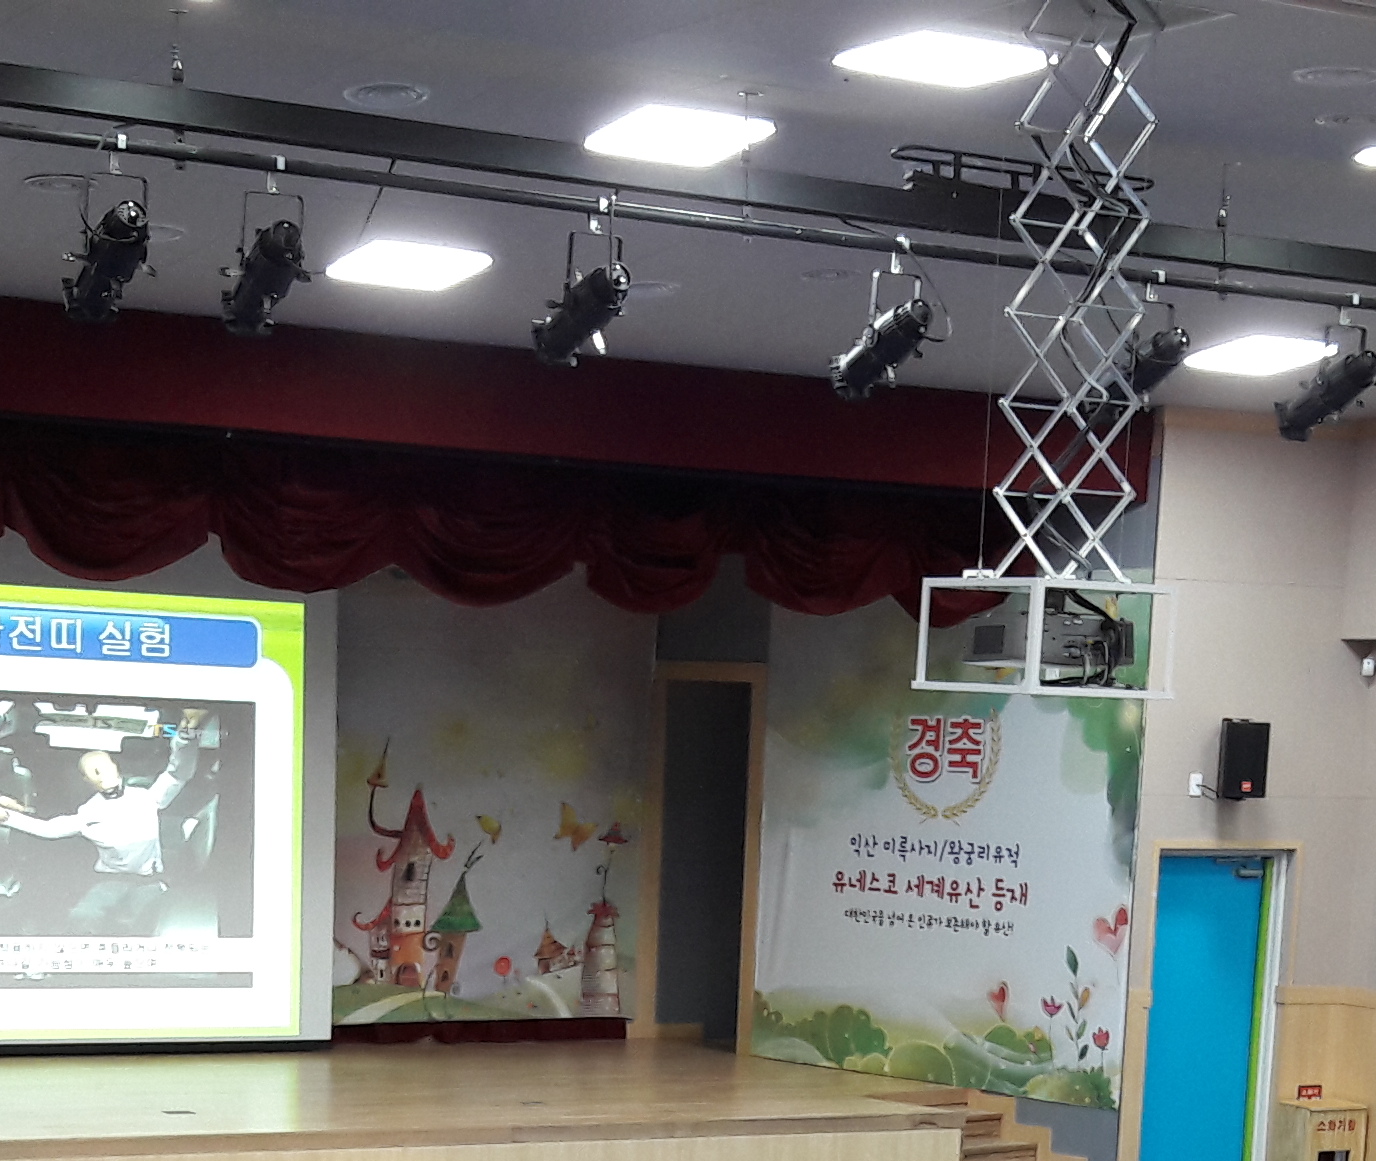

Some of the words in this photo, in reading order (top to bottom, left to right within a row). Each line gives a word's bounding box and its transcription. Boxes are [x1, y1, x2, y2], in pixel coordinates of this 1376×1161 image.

[99, 620, 171, 658] 실험
[907, 716, 984, 781] 경축
[850, 833, 878, 857] 익산
[832, 869, 899, 893] 유네스코
[905, 874, 985, 909] 세계유산
[992, 878, 1028, 911] 등재
